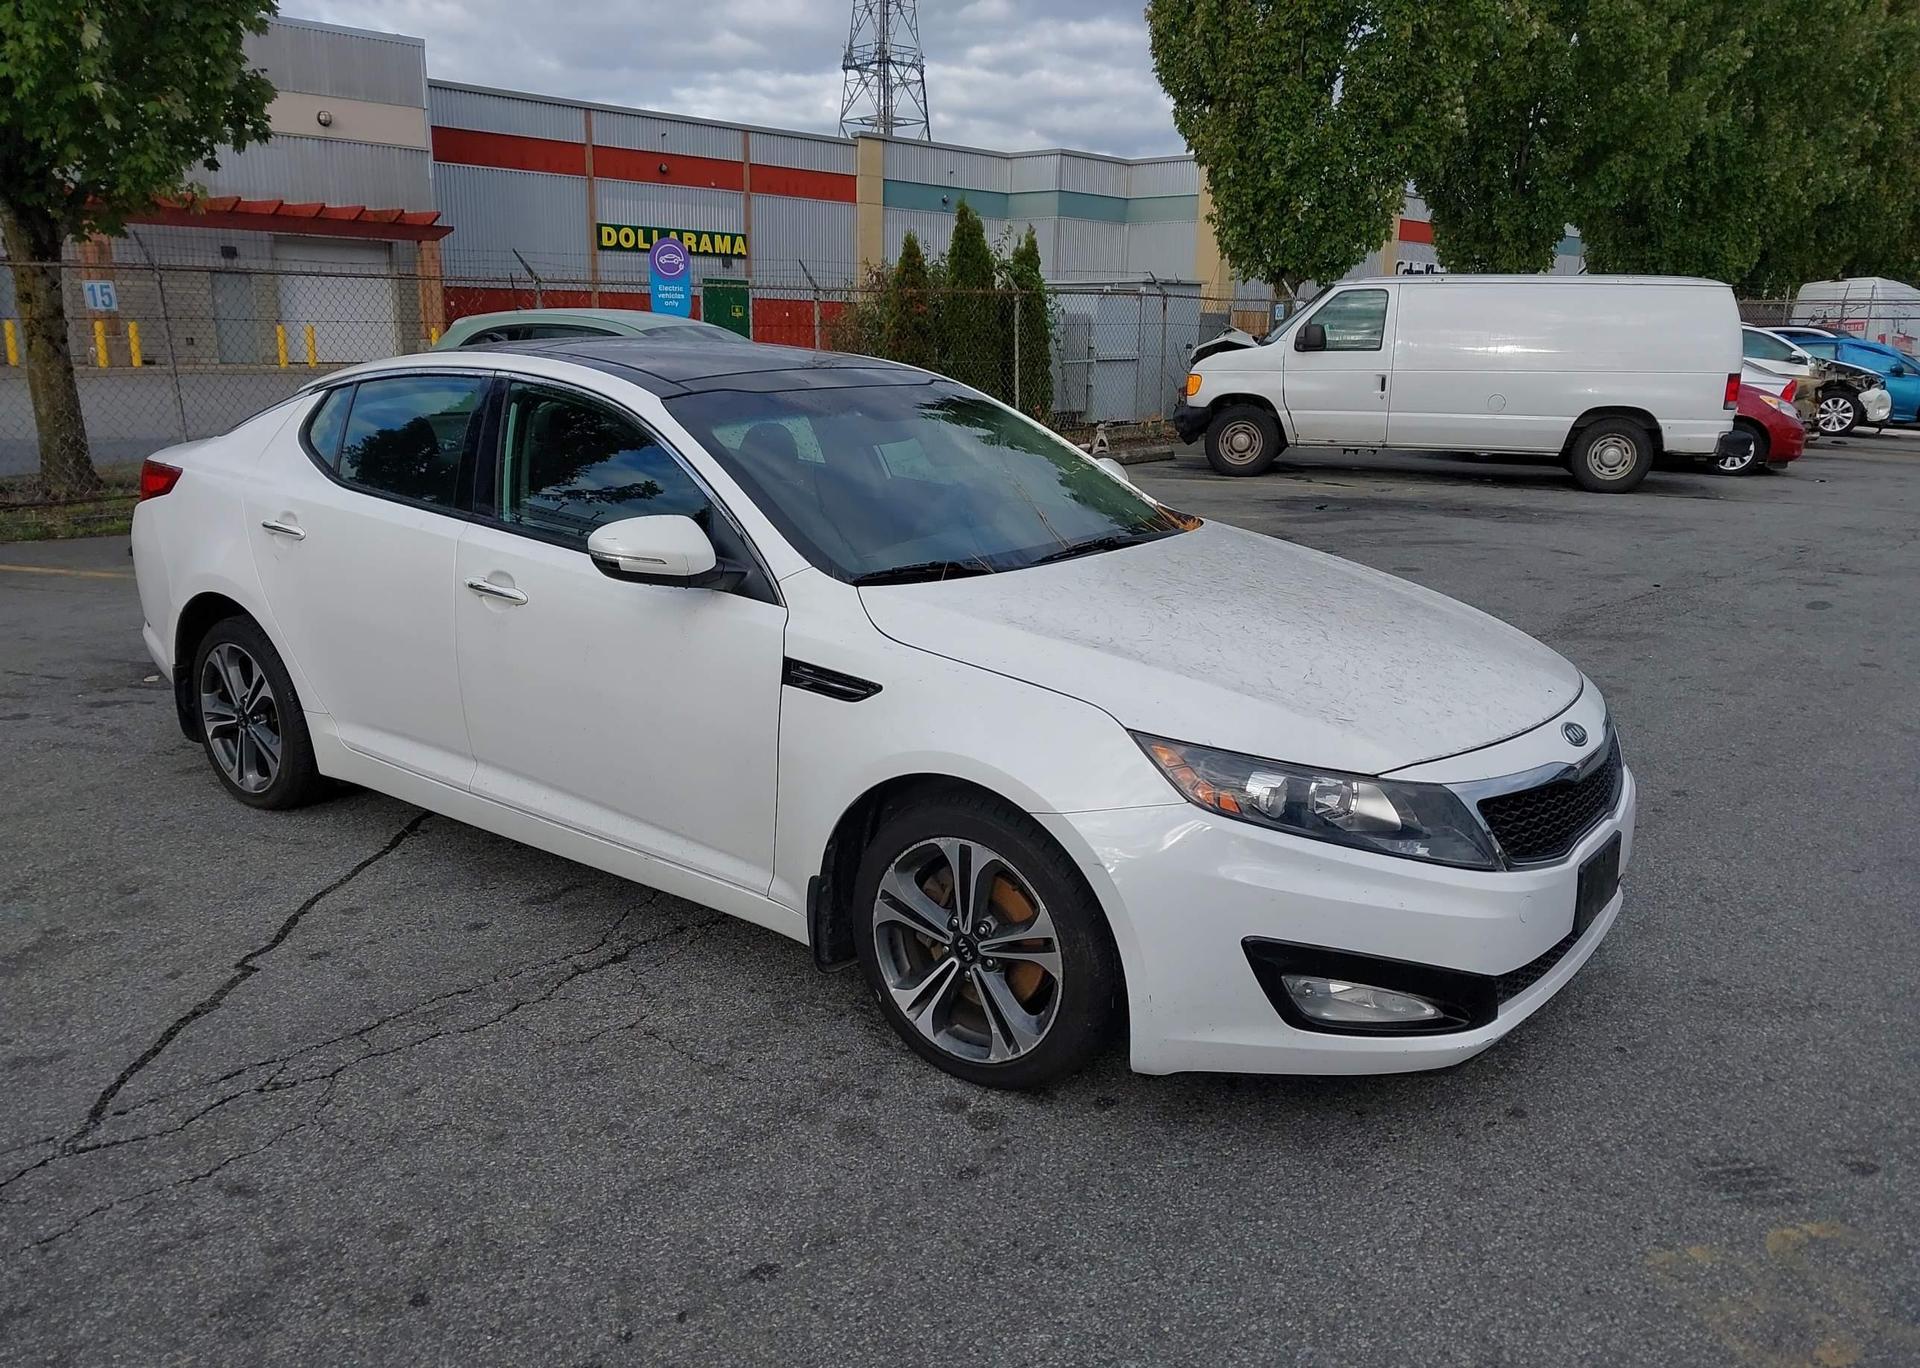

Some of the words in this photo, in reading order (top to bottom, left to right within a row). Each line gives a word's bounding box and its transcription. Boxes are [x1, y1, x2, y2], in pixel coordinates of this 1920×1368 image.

[658, 284, 684, 292] Electric
[87, 283, 113, 308] 15
[657, 292, 685, 300] vehicles
[664, 300, 679, 308] only
[958, 938, 973, 961] KIA
